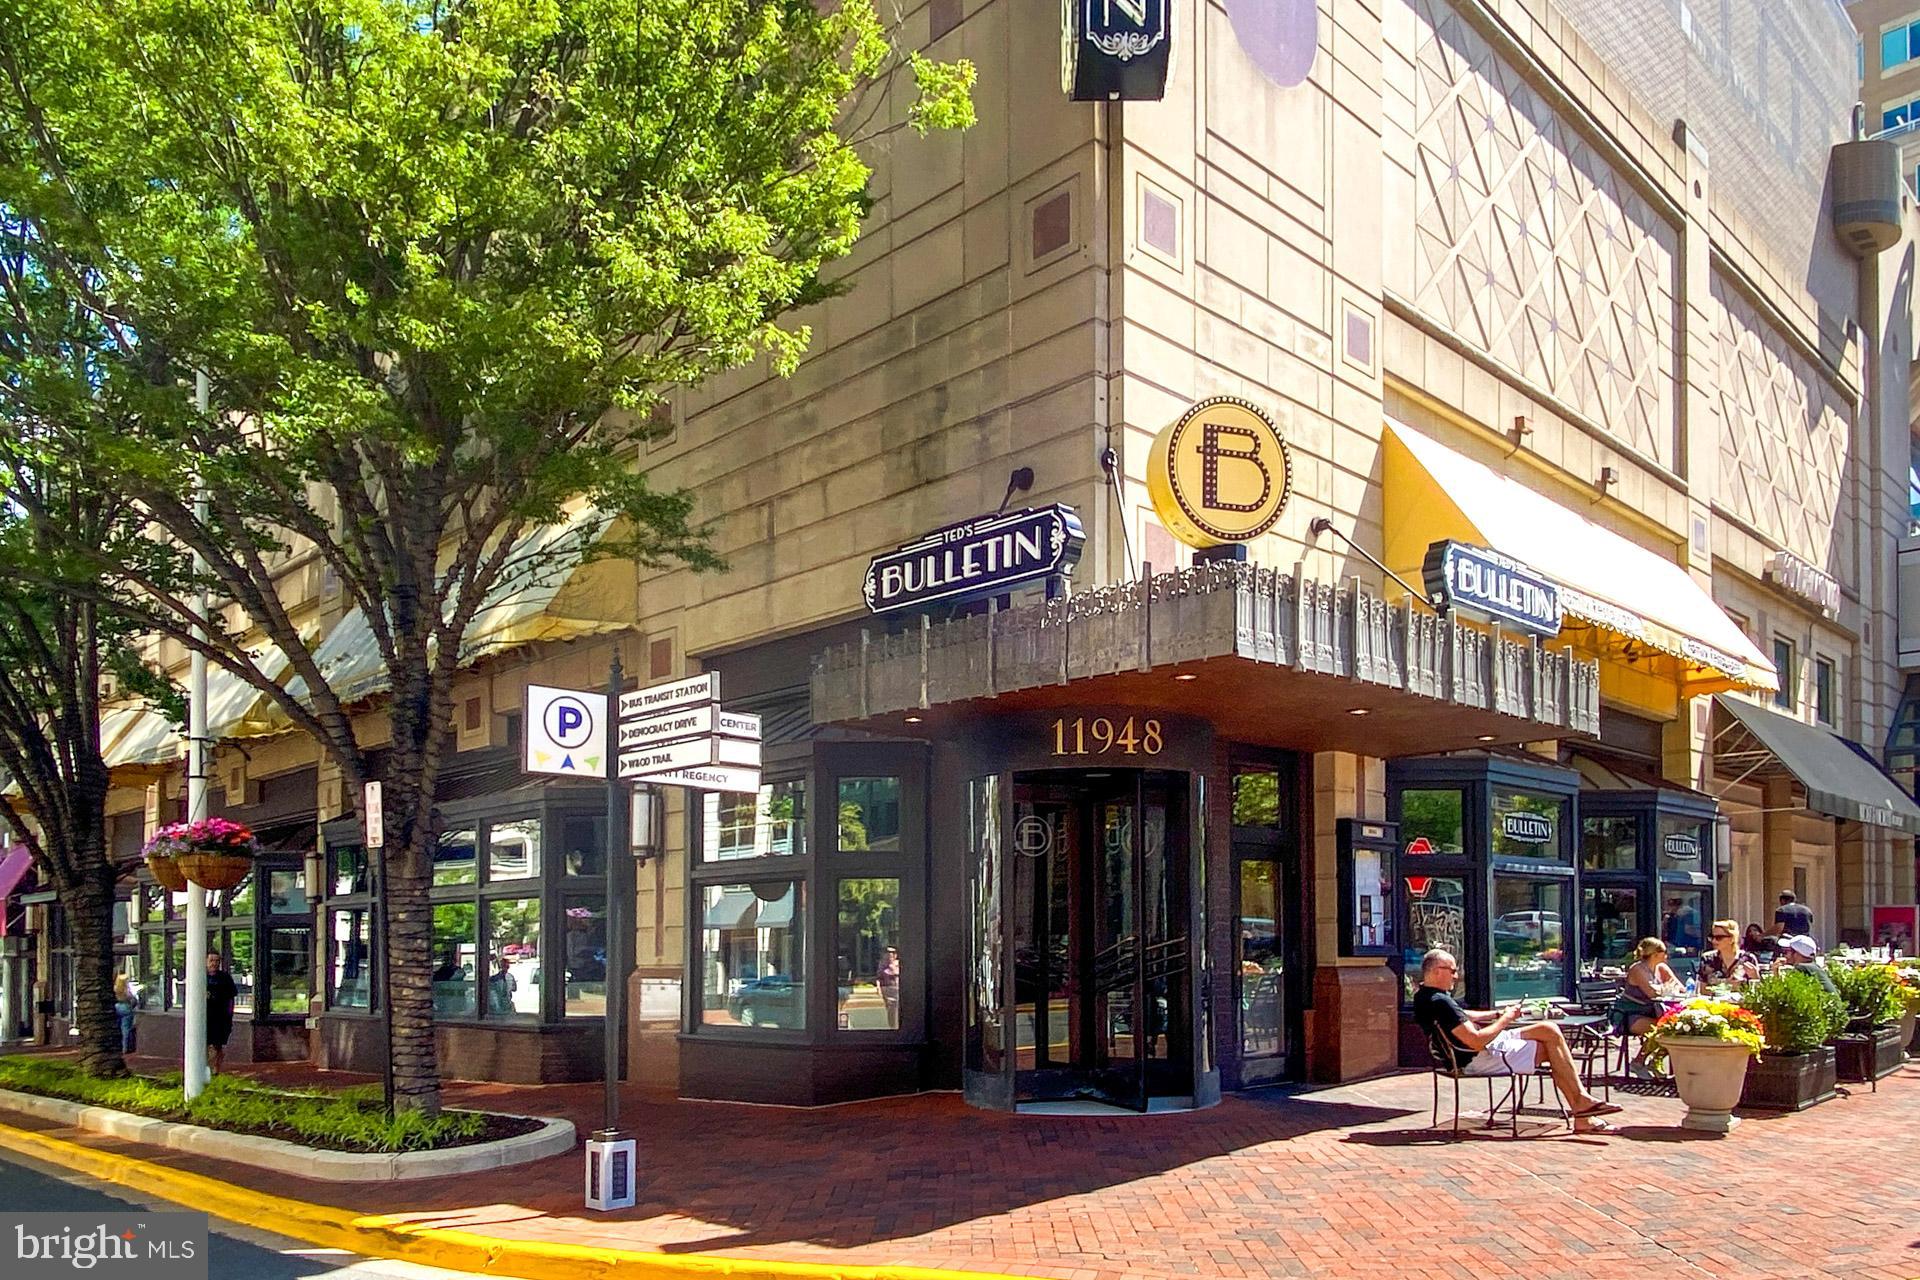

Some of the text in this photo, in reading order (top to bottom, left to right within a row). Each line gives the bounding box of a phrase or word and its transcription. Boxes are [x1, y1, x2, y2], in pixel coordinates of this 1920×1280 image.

[1196, 423, 1271, 513] B
[942, 523, 974, 545] TED'S
[881, 525, 1042, 599] BULLETIN
[1457, 556, 1554, 622] BULLETIN
[629, 682, 708, 709] BUS TRANSIT STATION
[558, 705, 583, 738] P
[628, 716, 698, 739] DEMOCRACY DRIVE
[720, 718, 757, 732] CENTER
[1051, 716, 1164, 756] 11948
[652, 753, 673, 765] TRAIL
[682, 769, 729, 783] REGENCY
[1507, 818, 1548, 837] BULLETIN
